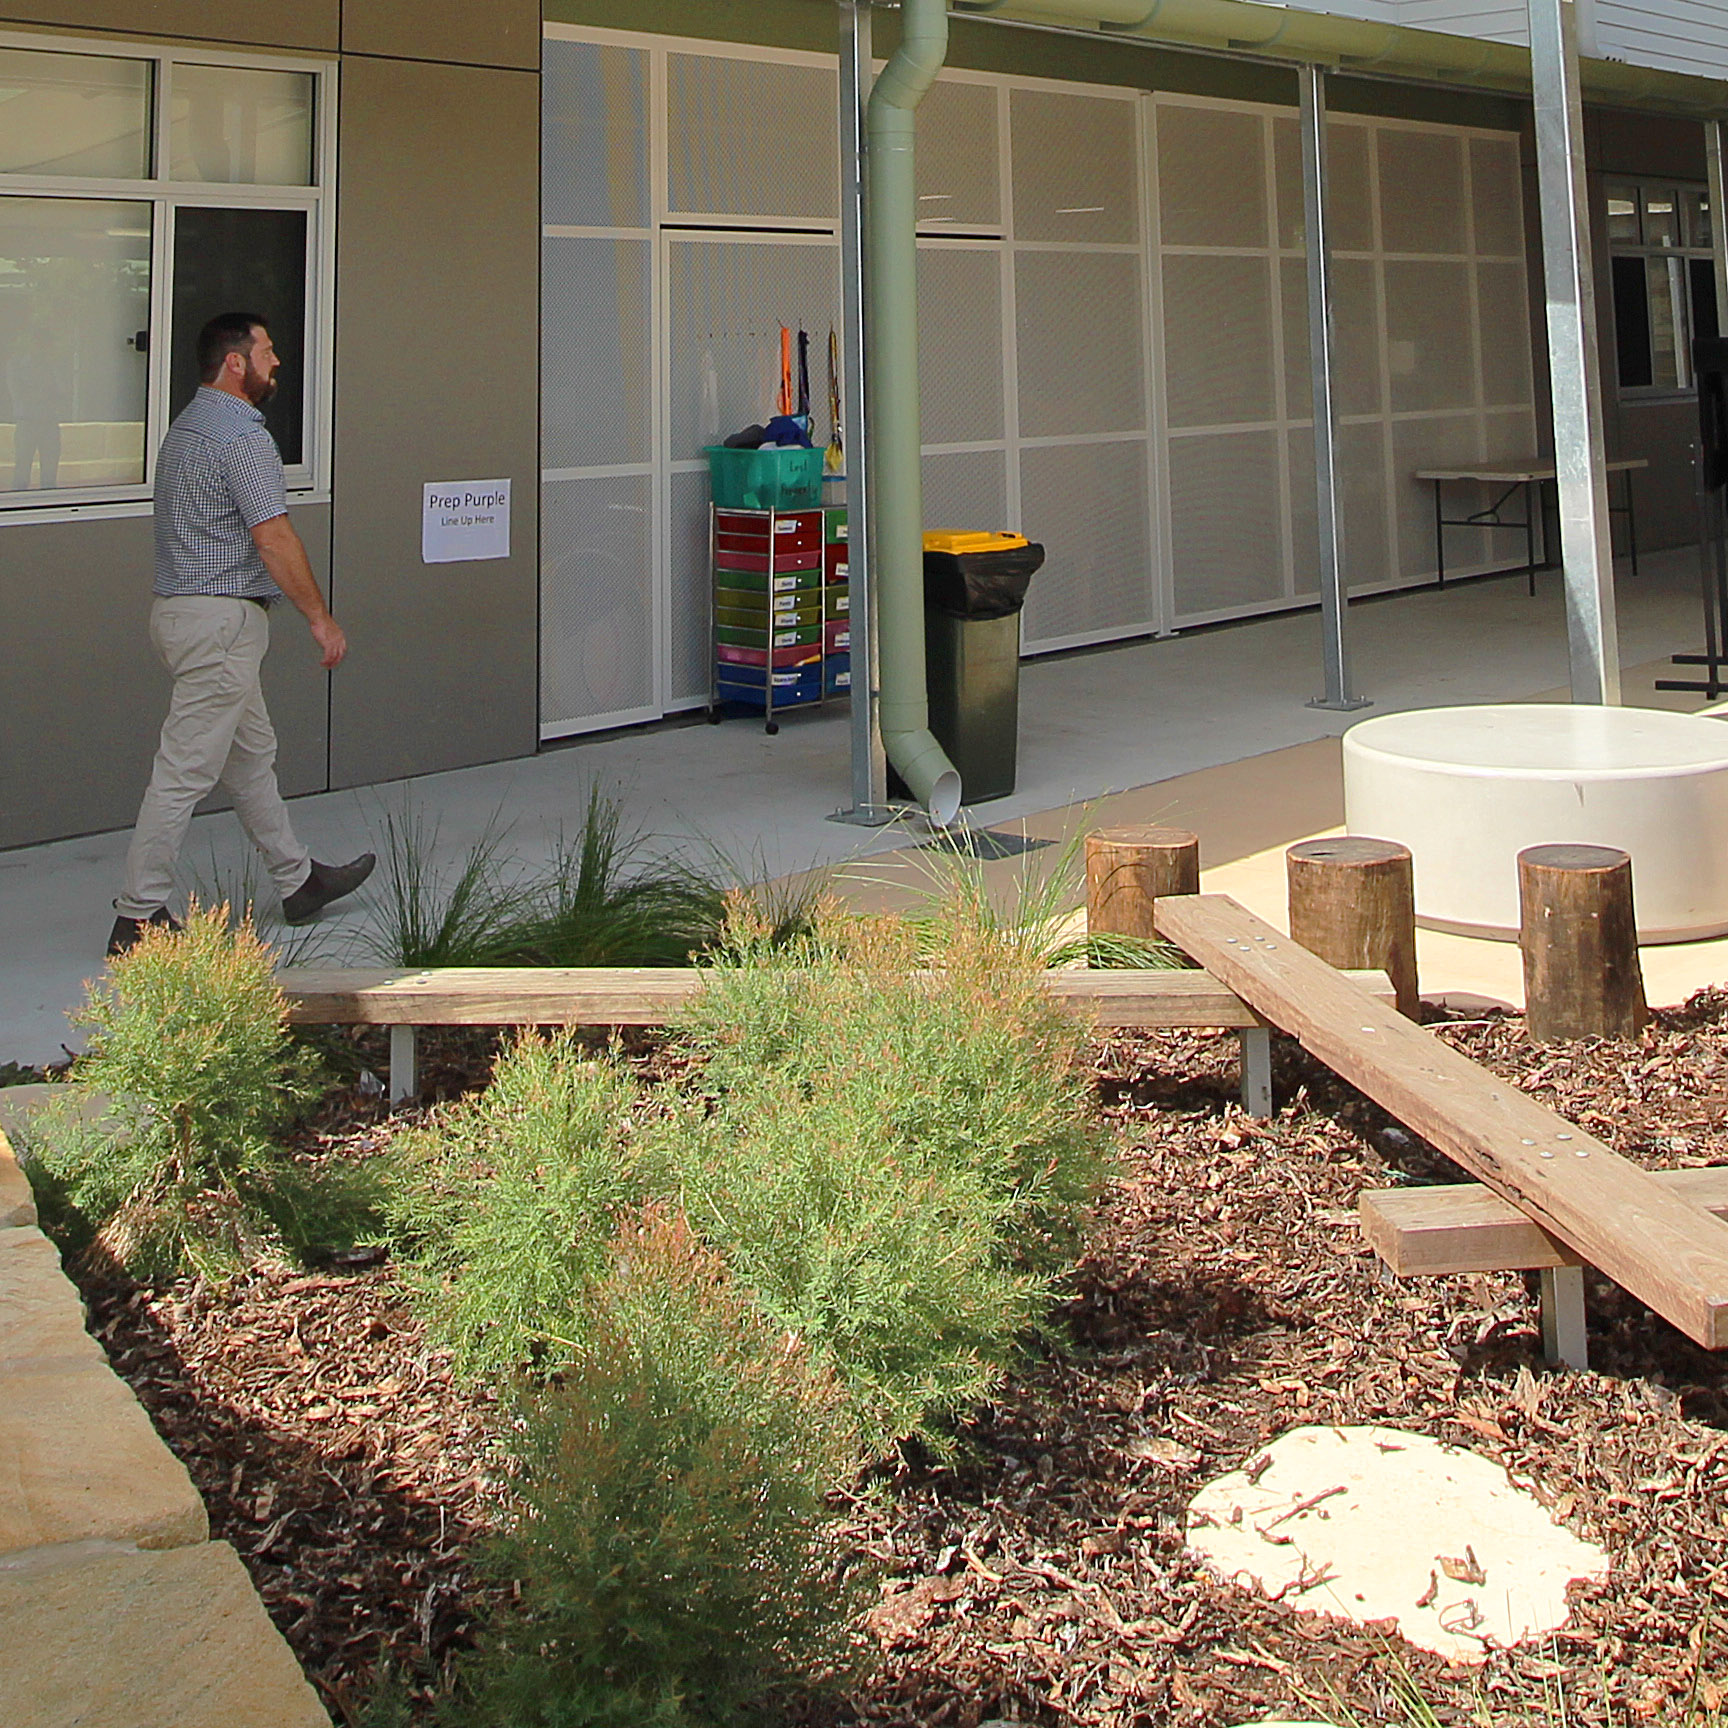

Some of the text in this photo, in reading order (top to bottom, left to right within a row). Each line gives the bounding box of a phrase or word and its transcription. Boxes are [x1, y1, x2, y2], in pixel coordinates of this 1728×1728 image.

[429, 490, 506, 512] Prep Purple
[441, 514, 495, 528] Line Up Here
